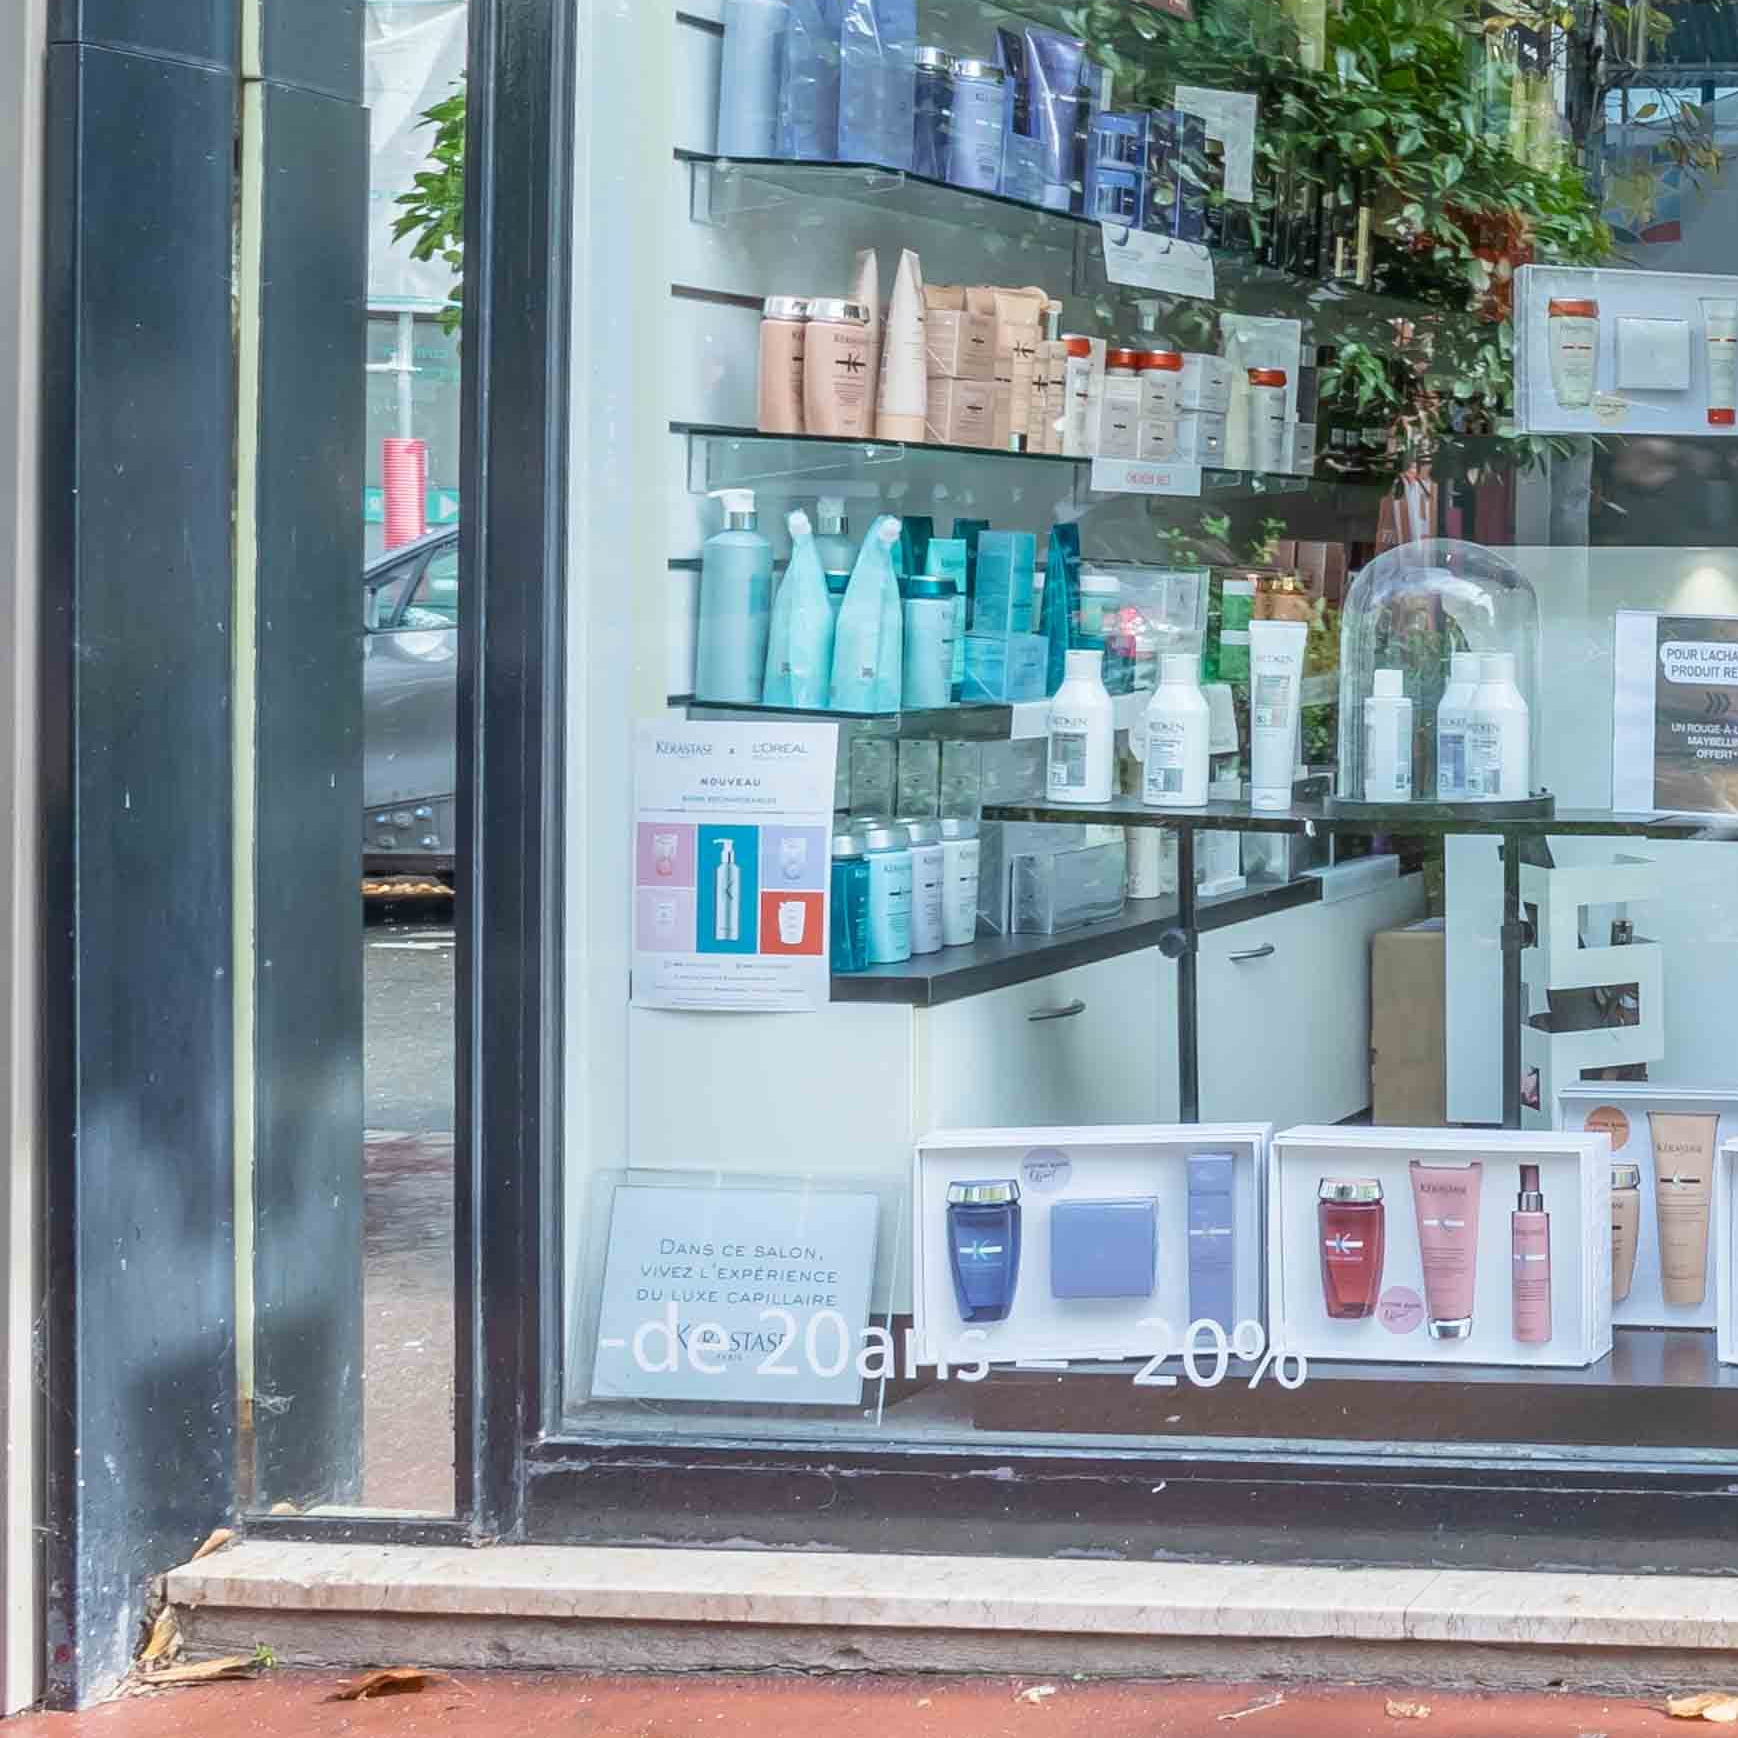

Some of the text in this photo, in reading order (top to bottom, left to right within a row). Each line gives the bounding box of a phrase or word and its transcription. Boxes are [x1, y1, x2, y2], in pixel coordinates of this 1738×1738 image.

[1666, 648, 1699, 661] POUR
[1671, 664, 1721, 679] PRODUIT
[700, 777, 761, 787] NOUVEAU
[635, 1288, 838, 1307] DU LUXE CAPILLAIRE
